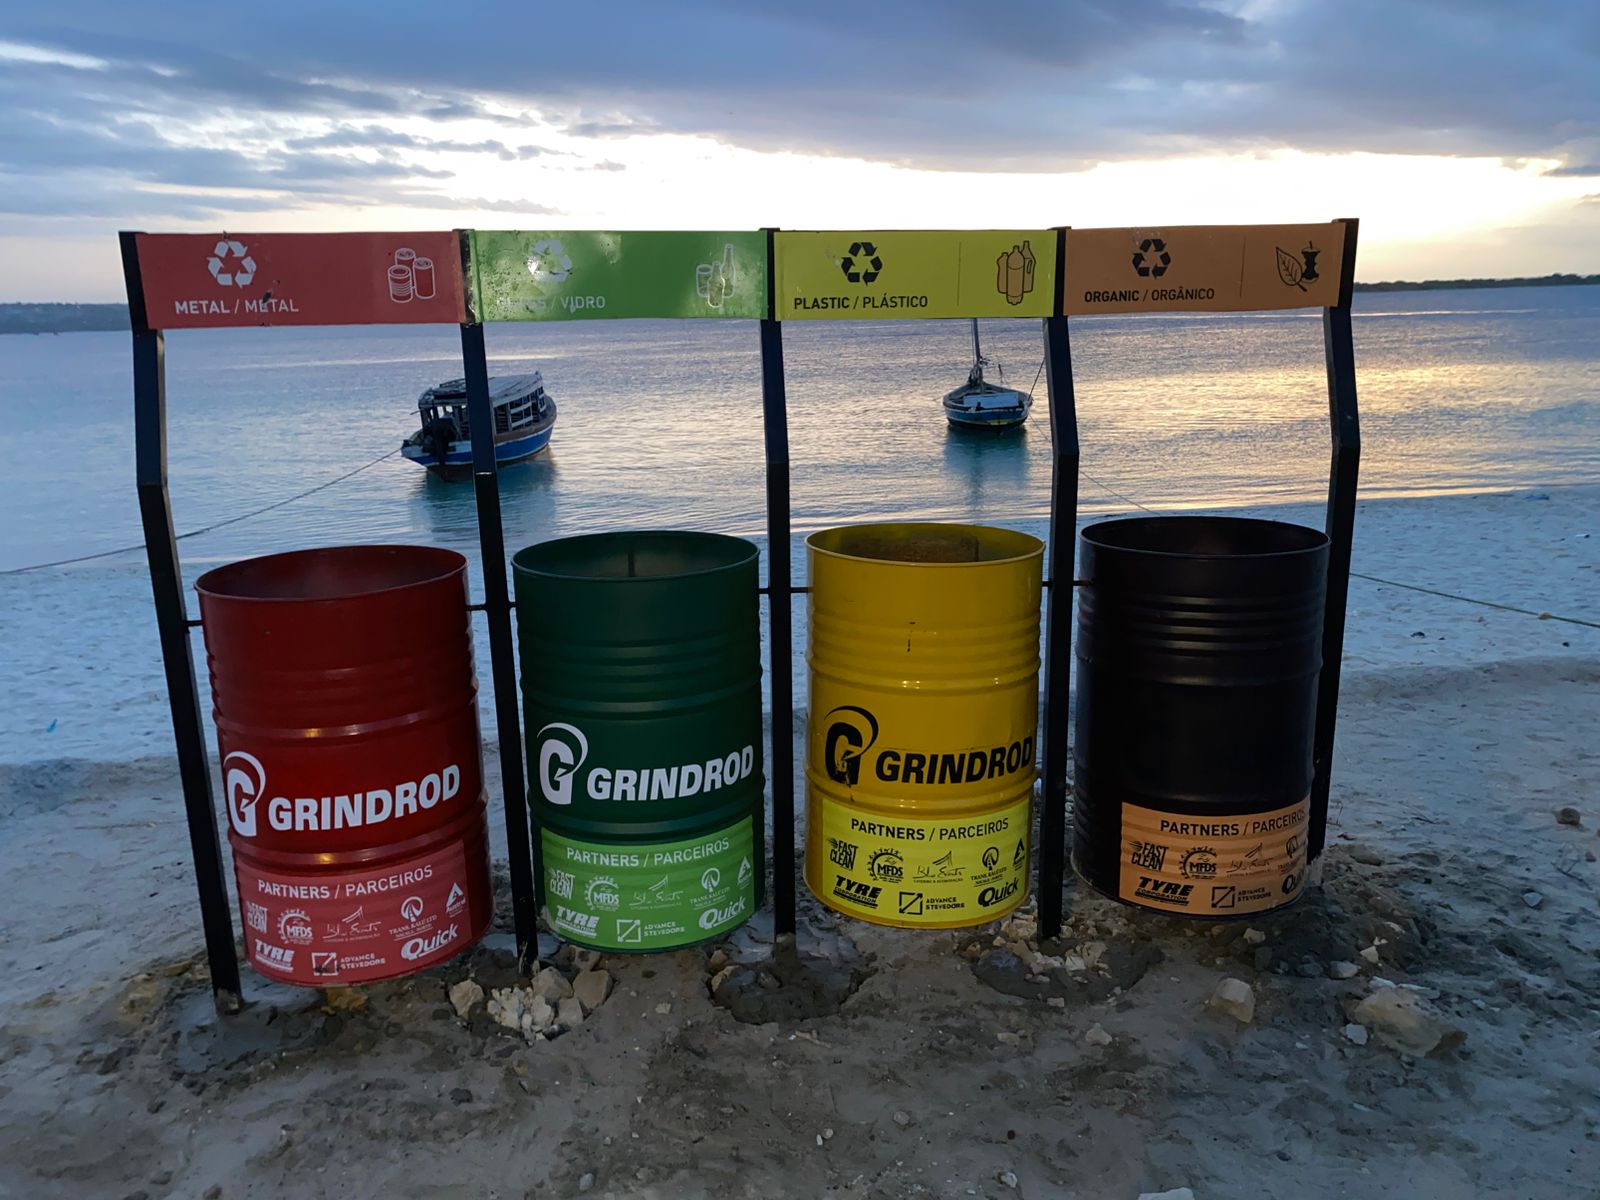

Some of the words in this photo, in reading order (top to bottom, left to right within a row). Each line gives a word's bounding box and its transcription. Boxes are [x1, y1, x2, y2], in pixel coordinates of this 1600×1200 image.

[560, 295, 606, 309] VIDRO
[794, 297, 850, 310] PLASTIC
[853, 296, 860, 309] /
[863, 293, 928, 309] PLÁSTICO
[1084, 290, 1140, 303] ORGANIC
[1142, 289, 1149, 302] /
[1151, 286, 1215, 301] ORGÂNICO
[175, 300, 230, 315] METAL
[234, 299, 240, 314] /
[876, 736, 1033, 784] GRINDROD
[587, 745, 754, 801] GRINDROD
[268, 764, 460, 831] GRINDROD
[851, 818, 925, 841] PARTNERS
[929, 828, 936, 842] /
[939, 818, 1009, 841] PARCEIROS
[1160, 819, 1239, 836] PARTNERS
[1243, 822, 1249, 836] /
[567, 847, 639, 867] PARTNERS
[643, 853, 650, 868] /
[654, 837, 730, 865] PARCEIROS
[830, 848, 855, 871] CLEAN
[1131, 851, 1164, 872] CLEAN
[877, 863, 904, 877] MFDS
[1189, 862, 1217, 873] MFDS
[258, 879, 330, 899] PARTNERS
[334, 884, 340, 899] /
[345, 864, 433, 896] PARCEIROS
[550, 878, 572, 900] CLEAN
[836, 875, 882, 898] TYRE
[1139, 876, 1194, 896] TYRE
[594, 892, 620, 905] MFDS
[977, 878, 1019, 908] Quick
[699, 896, 746, 929] Quick
[925, 902, 965, 910] STEVEDORE
[557, 905, 600, 929] TYRE
[644, 920, 676, 931] ADVANCE
[286, 924, 313, 938] MFDS
[401, 923, 458, 960] Quick
[644, 926, 685, 936] STEVEDORE
[255, 939, 295, 963] TYRE
[340, 952, 375, 963] ADVANCE
